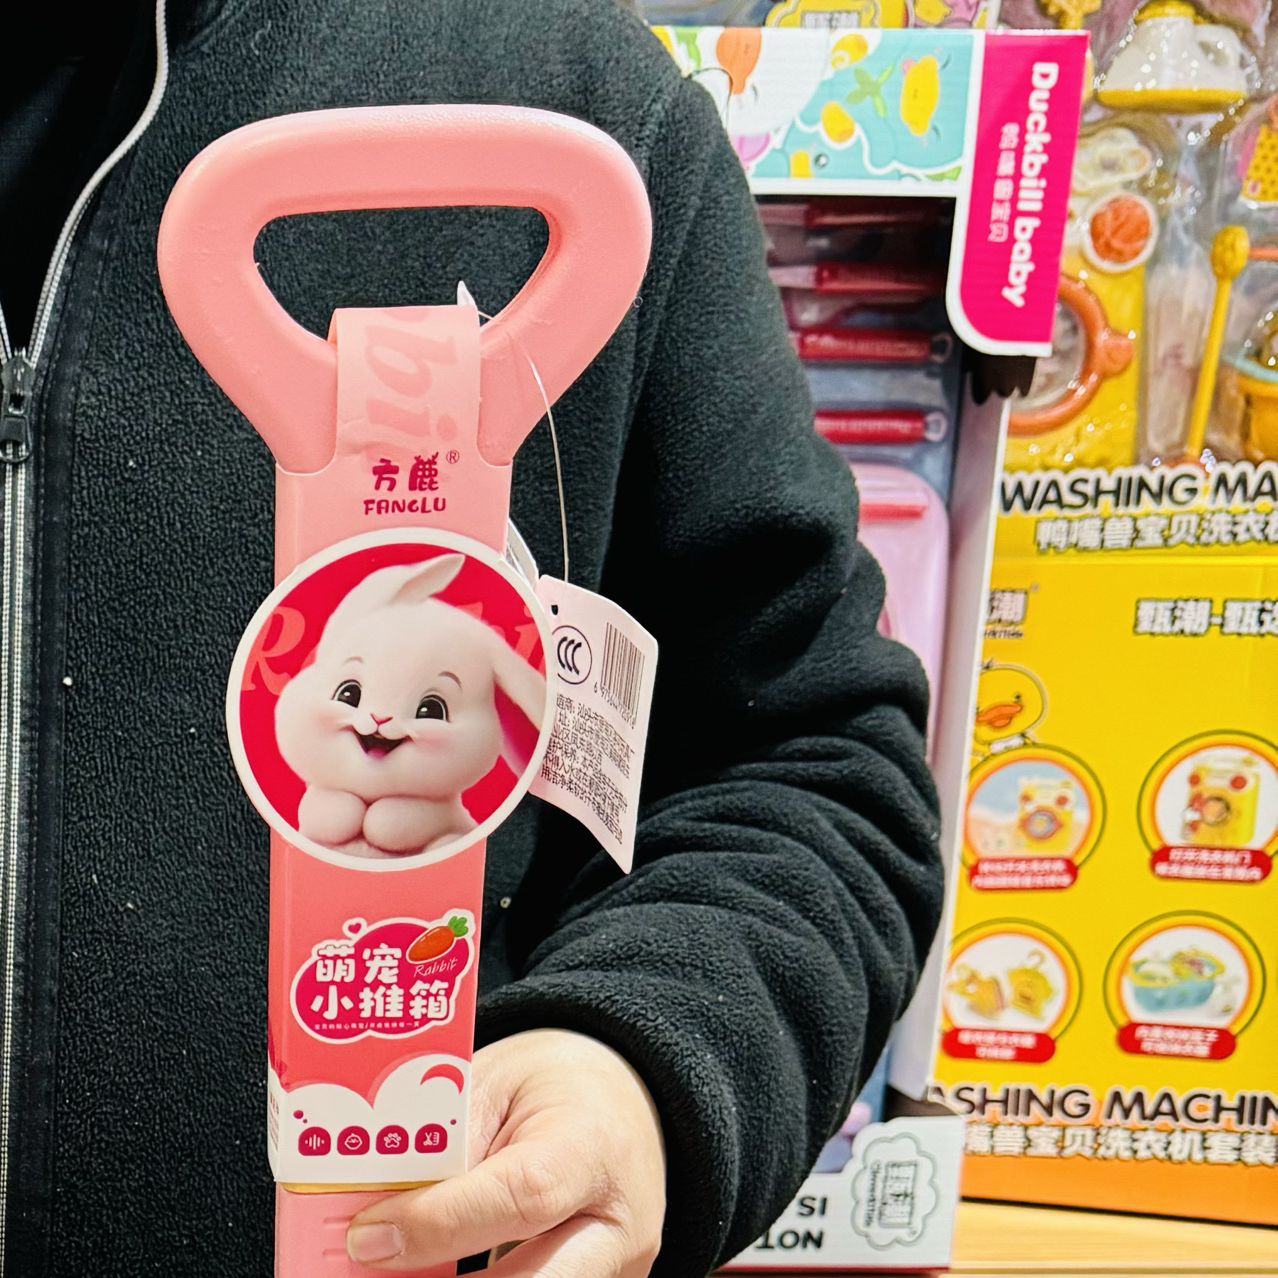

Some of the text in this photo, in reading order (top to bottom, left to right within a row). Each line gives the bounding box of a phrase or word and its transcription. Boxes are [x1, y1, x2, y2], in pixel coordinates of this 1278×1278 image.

[1001, 62, 1059, 308] Duckbill baby
[363, 496, 447, 516] FANGLU
[1001, 473, 1199, 513] WASHING
[315, 943, 403, 984] 萌宠
[413, 957, 459, 978] Rabbit
[310, 979, 450, 1021] 小推箱
